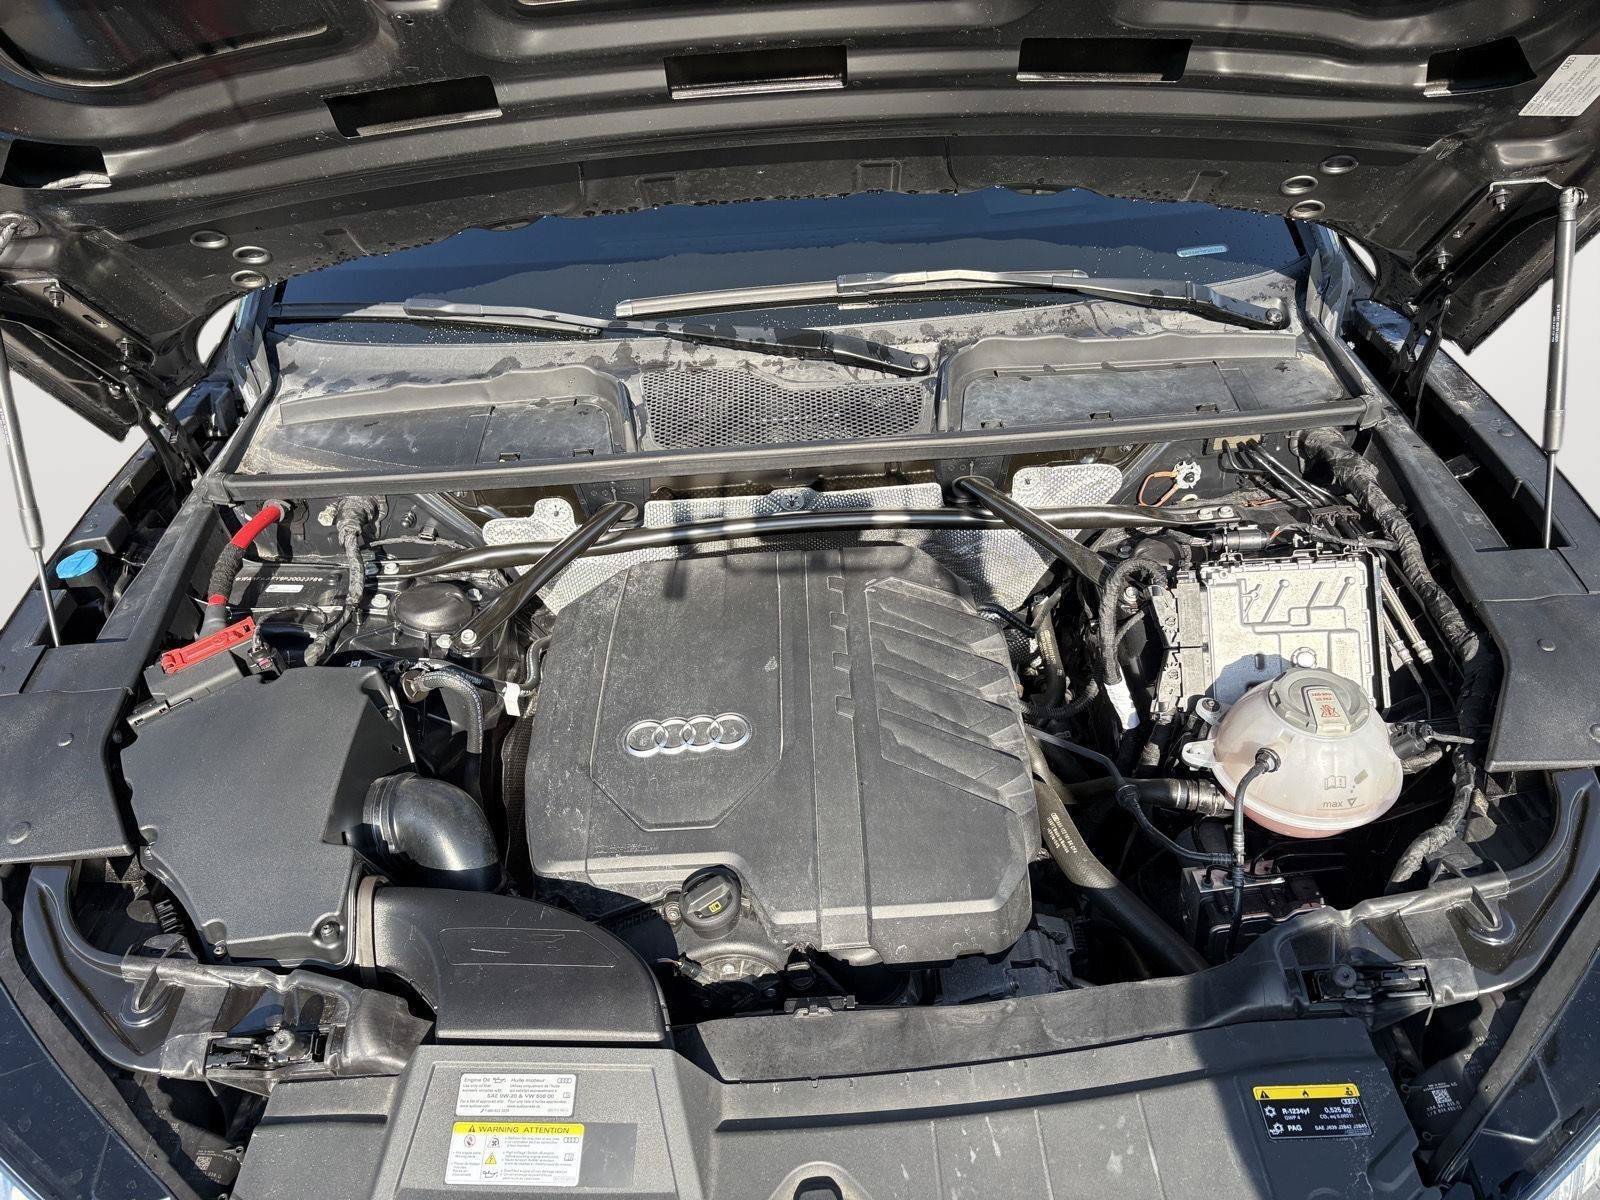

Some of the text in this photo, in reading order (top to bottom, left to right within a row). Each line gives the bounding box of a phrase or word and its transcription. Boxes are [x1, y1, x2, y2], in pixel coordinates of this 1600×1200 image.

[1321, 800, 1344, 808] max
[1282, 1107, 1311, 1115] R-1234yf
[1342, 1106, 1352, 1114] kg
[523, 1126, 569, 1134] ATTENTION
[1286, 1124, 1303, 1132] PAG
